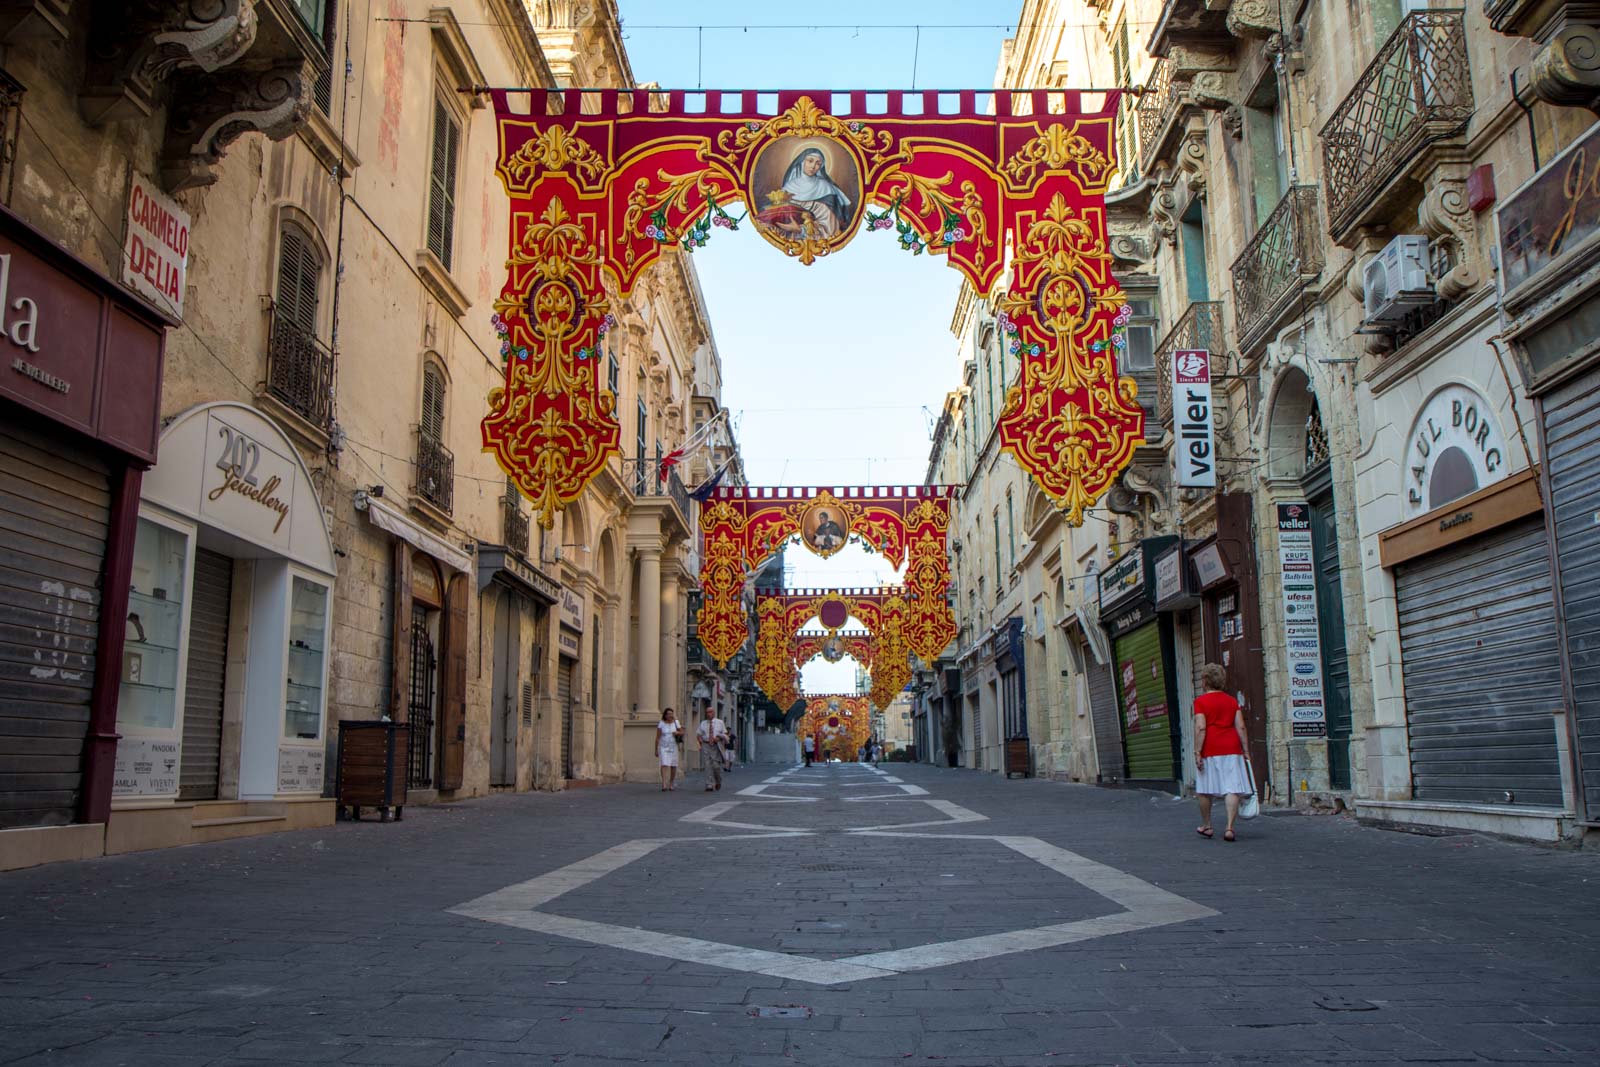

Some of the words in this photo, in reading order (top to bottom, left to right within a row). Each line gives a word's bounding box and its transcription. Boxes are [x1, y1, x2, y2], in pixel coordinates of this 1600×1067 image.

[132, 185, 187, 258] CARMELO
[130, 233, 179, 302] DELIA
[12, 358, 70, 394] JEWELLERY
[1181, 389, 1211, 478] veller
[217, 427, 260, 487] 202
[1409, 417, 1441, 504] PAUL
[1452, 400, 1501, 472] BORG
[209, 464, 289, 534] Jewellery
[1280, 519, 1309, 529] veller
[1296, 603, 1314, 611] pure
[1293, 640, 1317, 648] PRINCESS
[1292, 677, 1319, 688] Rayen
[152, 744, 177, 752] PANDORA
[114, 779, 138, 787] AMILIA
